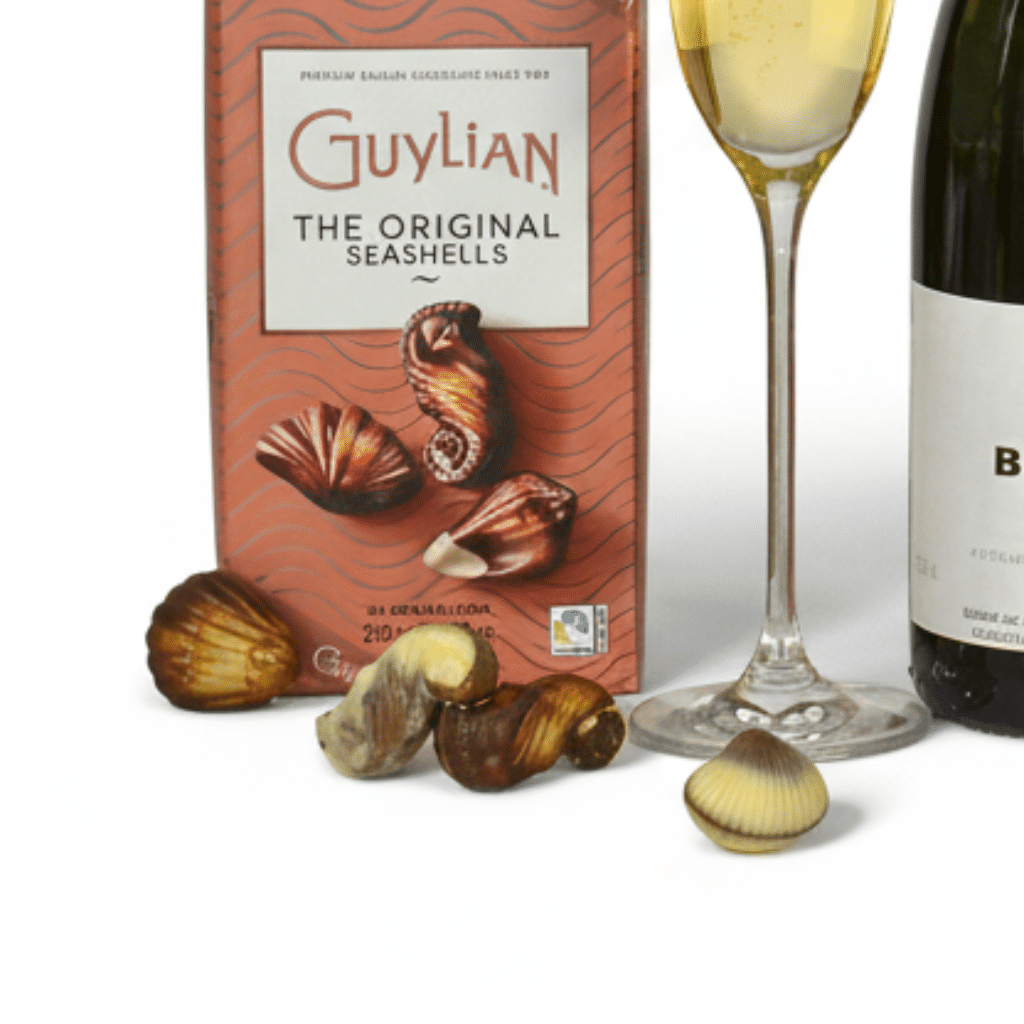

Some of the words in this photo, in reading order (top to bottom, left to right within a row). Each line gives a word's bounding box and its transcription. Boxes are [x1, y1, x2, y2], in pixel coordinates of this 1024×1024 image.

[292, 213, 363, 241] THE
[379, 212, 560, 239] ORIGINAL
[346, 243, 509, 266] SEASHELLS
